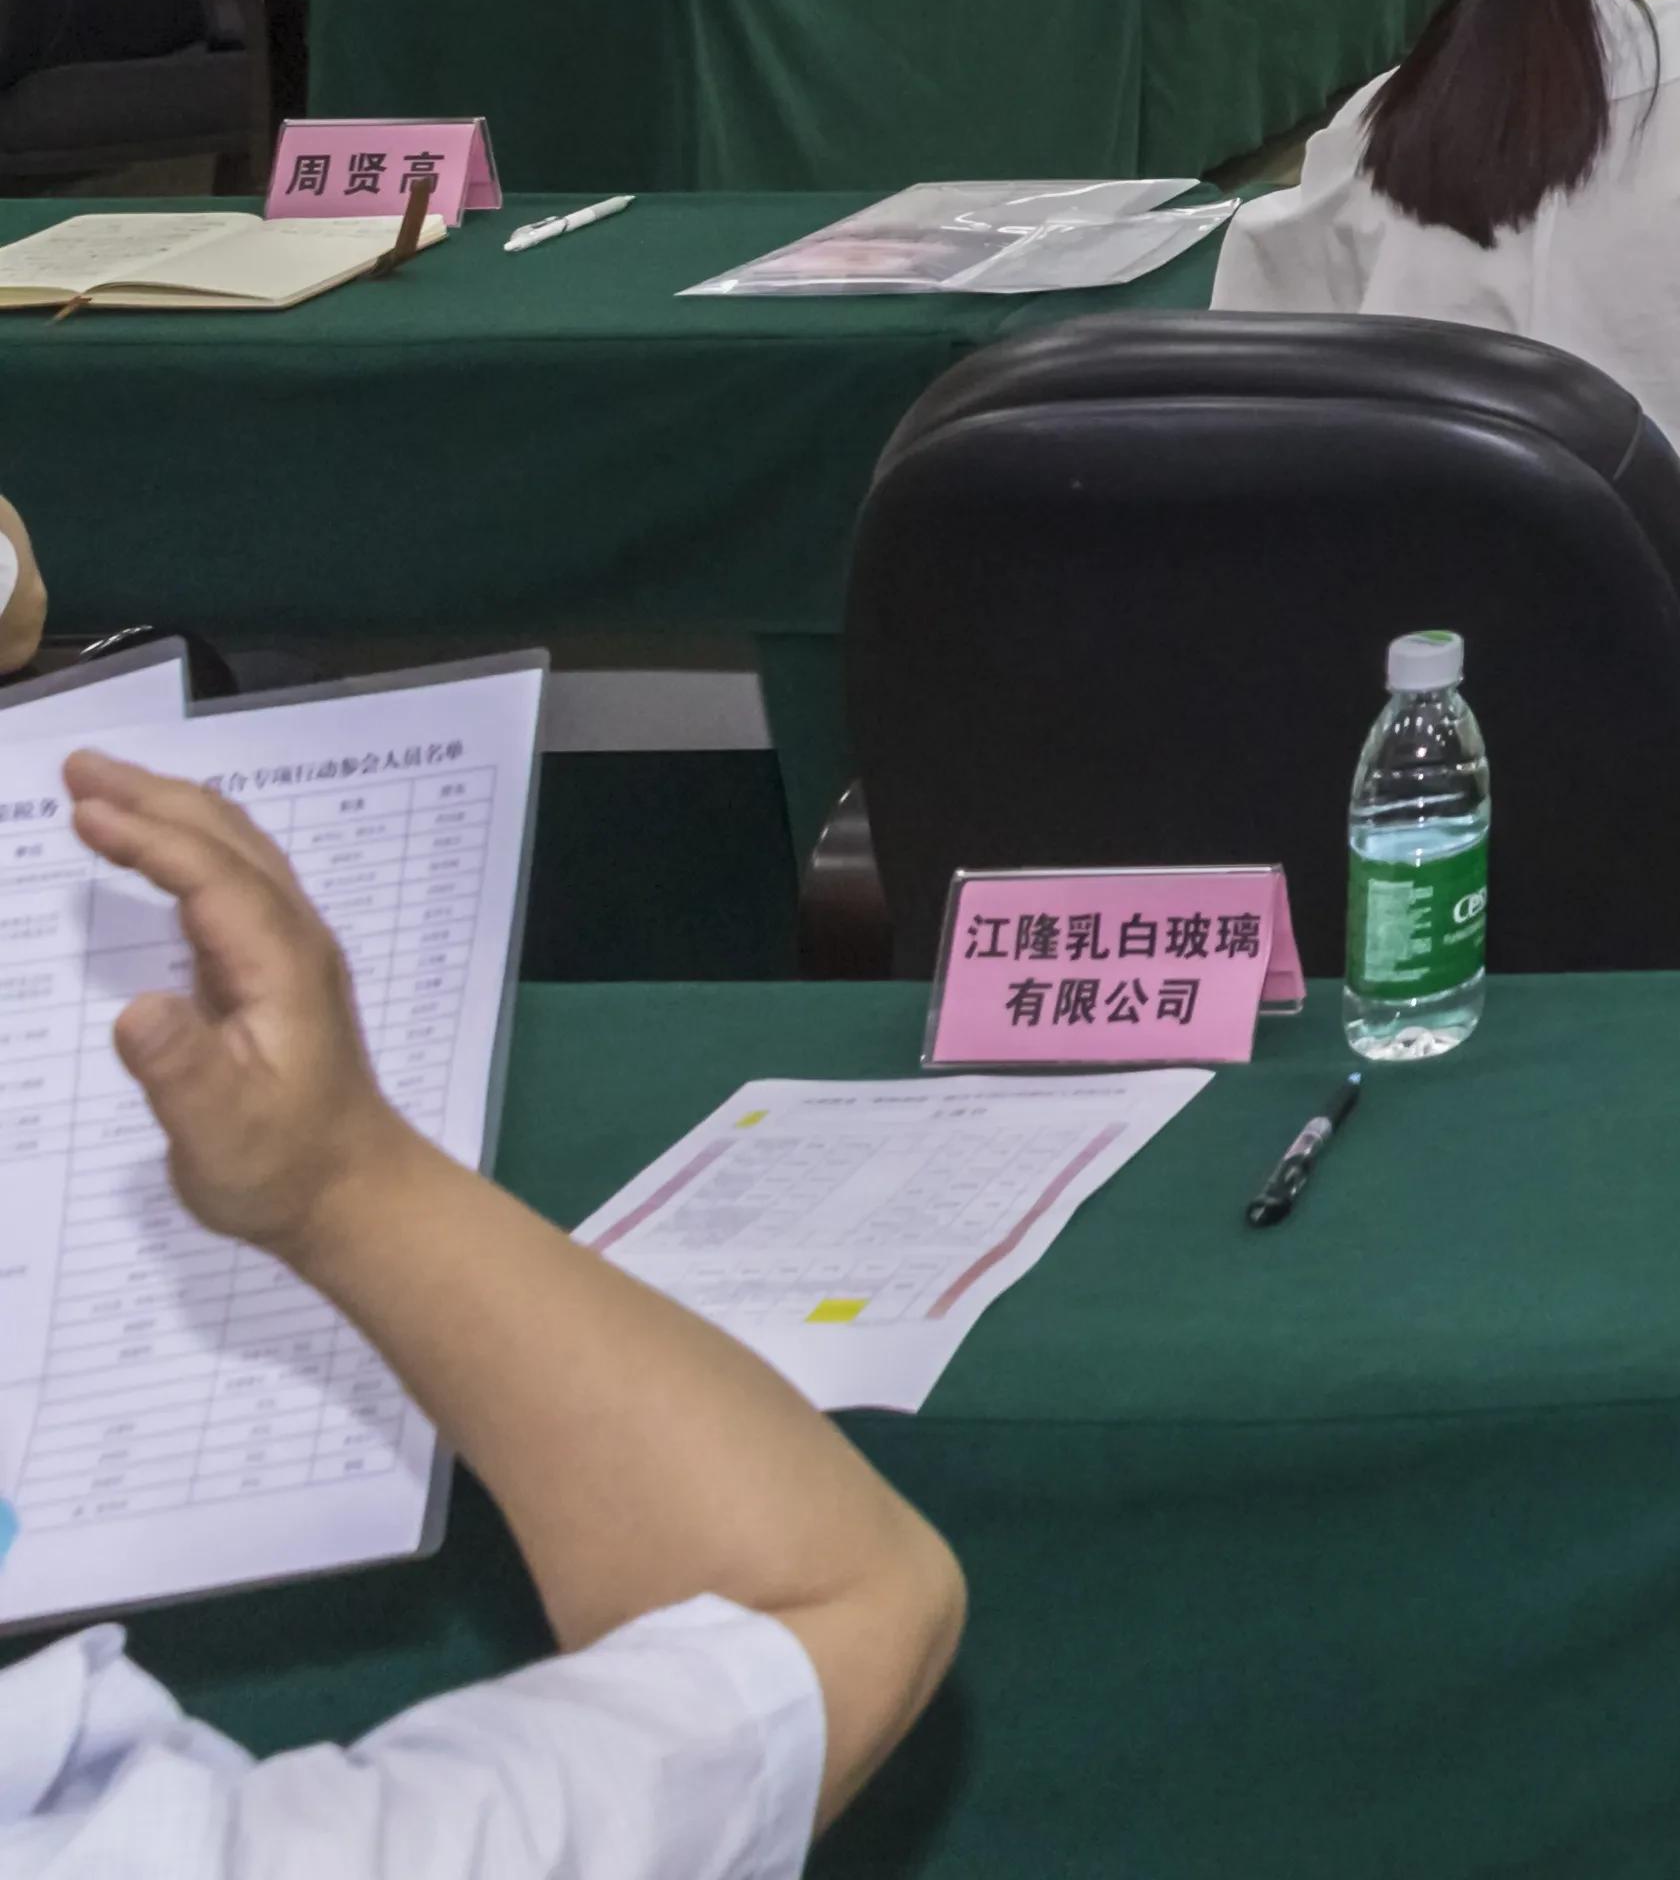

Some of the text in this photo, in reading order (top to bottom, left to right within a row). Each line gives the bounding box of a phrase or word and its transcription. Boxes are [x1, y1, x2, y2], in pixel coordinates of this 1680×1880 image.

[285, 150, 446, 197] 周贤高
[963, 911, 1262, 962] 江隆乳白玻璃
[1004, 977, 1201, 1027] 有限公司
